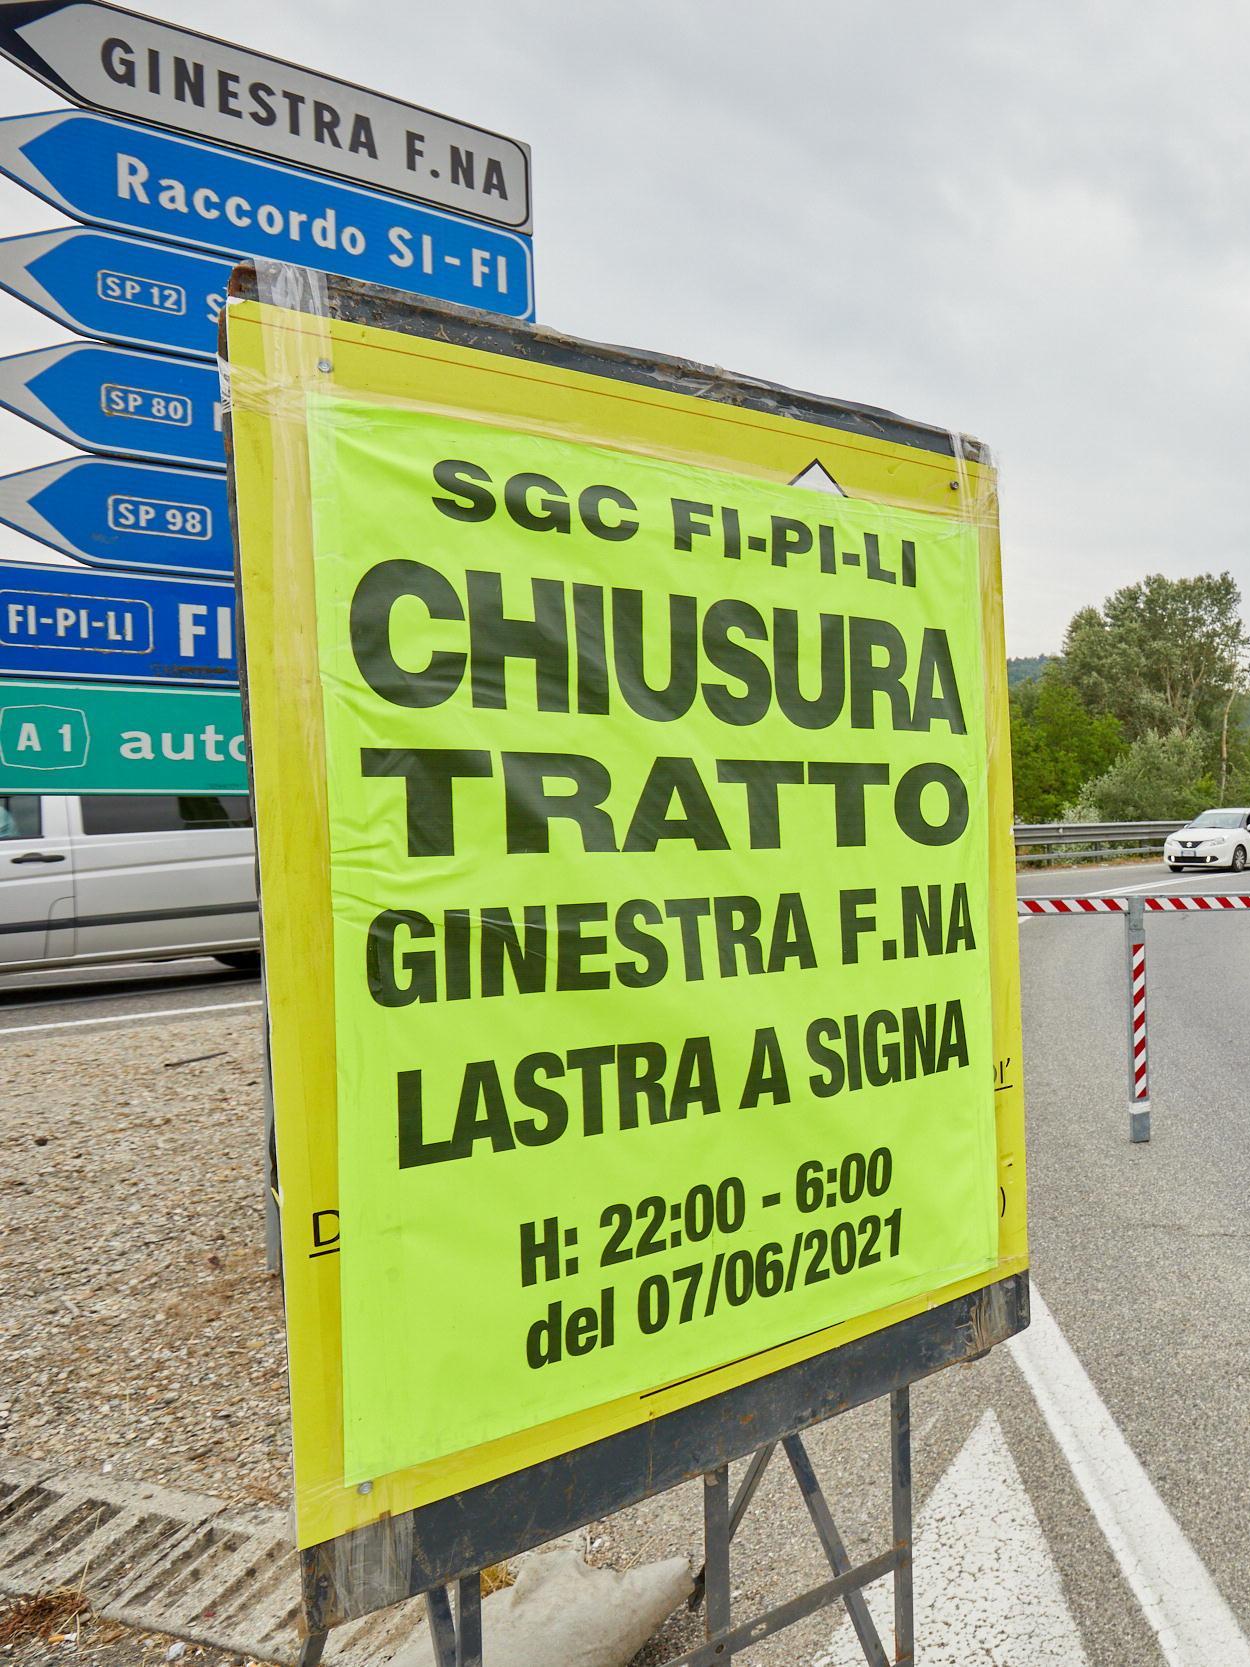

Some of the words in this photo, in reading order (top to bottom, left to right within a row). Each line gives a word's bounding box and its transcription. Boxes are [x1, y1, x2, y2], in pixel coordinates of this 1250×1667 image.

[101, 37, 378, 160] GINESTRA
[405, 129, 509, 201] F.NA
[116, 152, 366, 256] Raccordo
[388, 227, 508, 294] SI-FI
[105, 277, 142, 300] SP
[150, 286, 178, 309] 12
[110, 390, 142, 413] SP
[152, 398, 183, 419] 80
[118, 503, 156, 531] SP
[166, 507, 202, 534] 98
[432, 458, 640, 542] SGC
[671, 498, 917, 588] FI-PI-LI
[7, 603, 133, 642] FI-PI-LI
[349, 558, 967, 735] CHIUSURA
[16, 722, 41, 752] A
[57, 723, 72, 752] 1
[360, 747, 969, 858] TRATTO
[365, 892, 818, 1008] GINESTRA
[839, 882, 976, 963] F.NA
[397, 1036, 721, 1170] LASTRA
[739, 1027, 792, 1110] A
[807, 999, 970, 1099] SIGNA
[519, 1221, 580, 1288] H:
[600, 1176, 745, 1264] 22:00
[796, 1147, 893, 1214] 6:00
[525, 1286, 616, 1370] del
[637, 1208, 903, 1335] 07/06/2021
